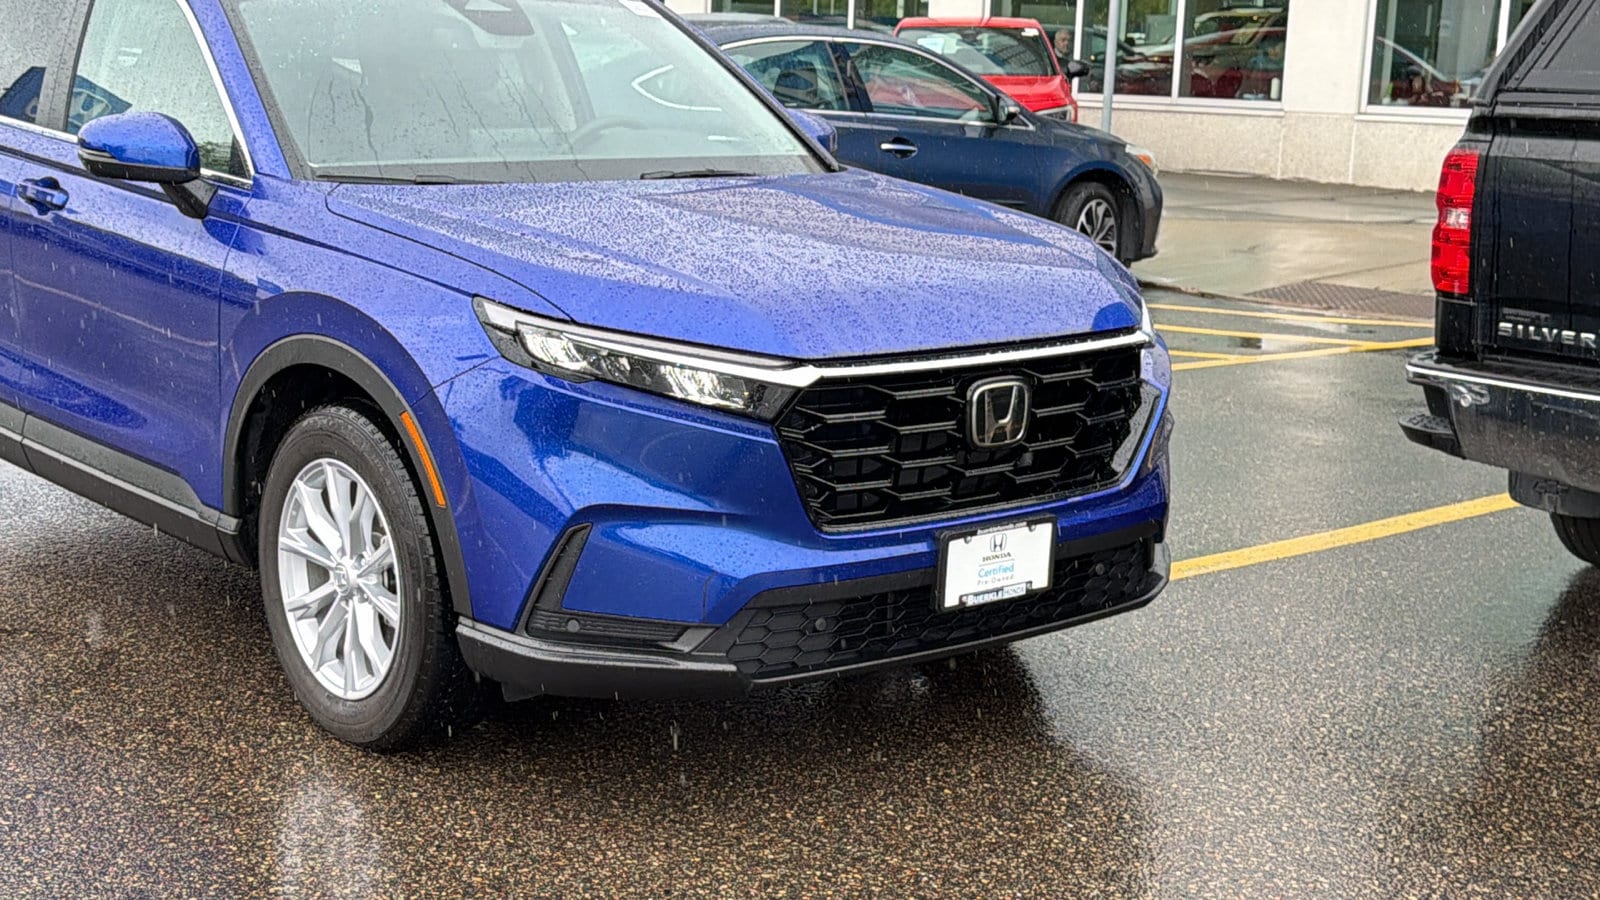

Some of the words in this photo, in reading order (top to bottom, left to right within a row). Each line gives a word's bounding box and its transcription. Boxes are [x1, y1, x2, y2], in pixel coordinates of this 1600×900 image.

[1497, 322, 1596, 348] SILVER
[982, 552, 1012, 562] HONDA
[978, 564, 1014, 578] Certified
